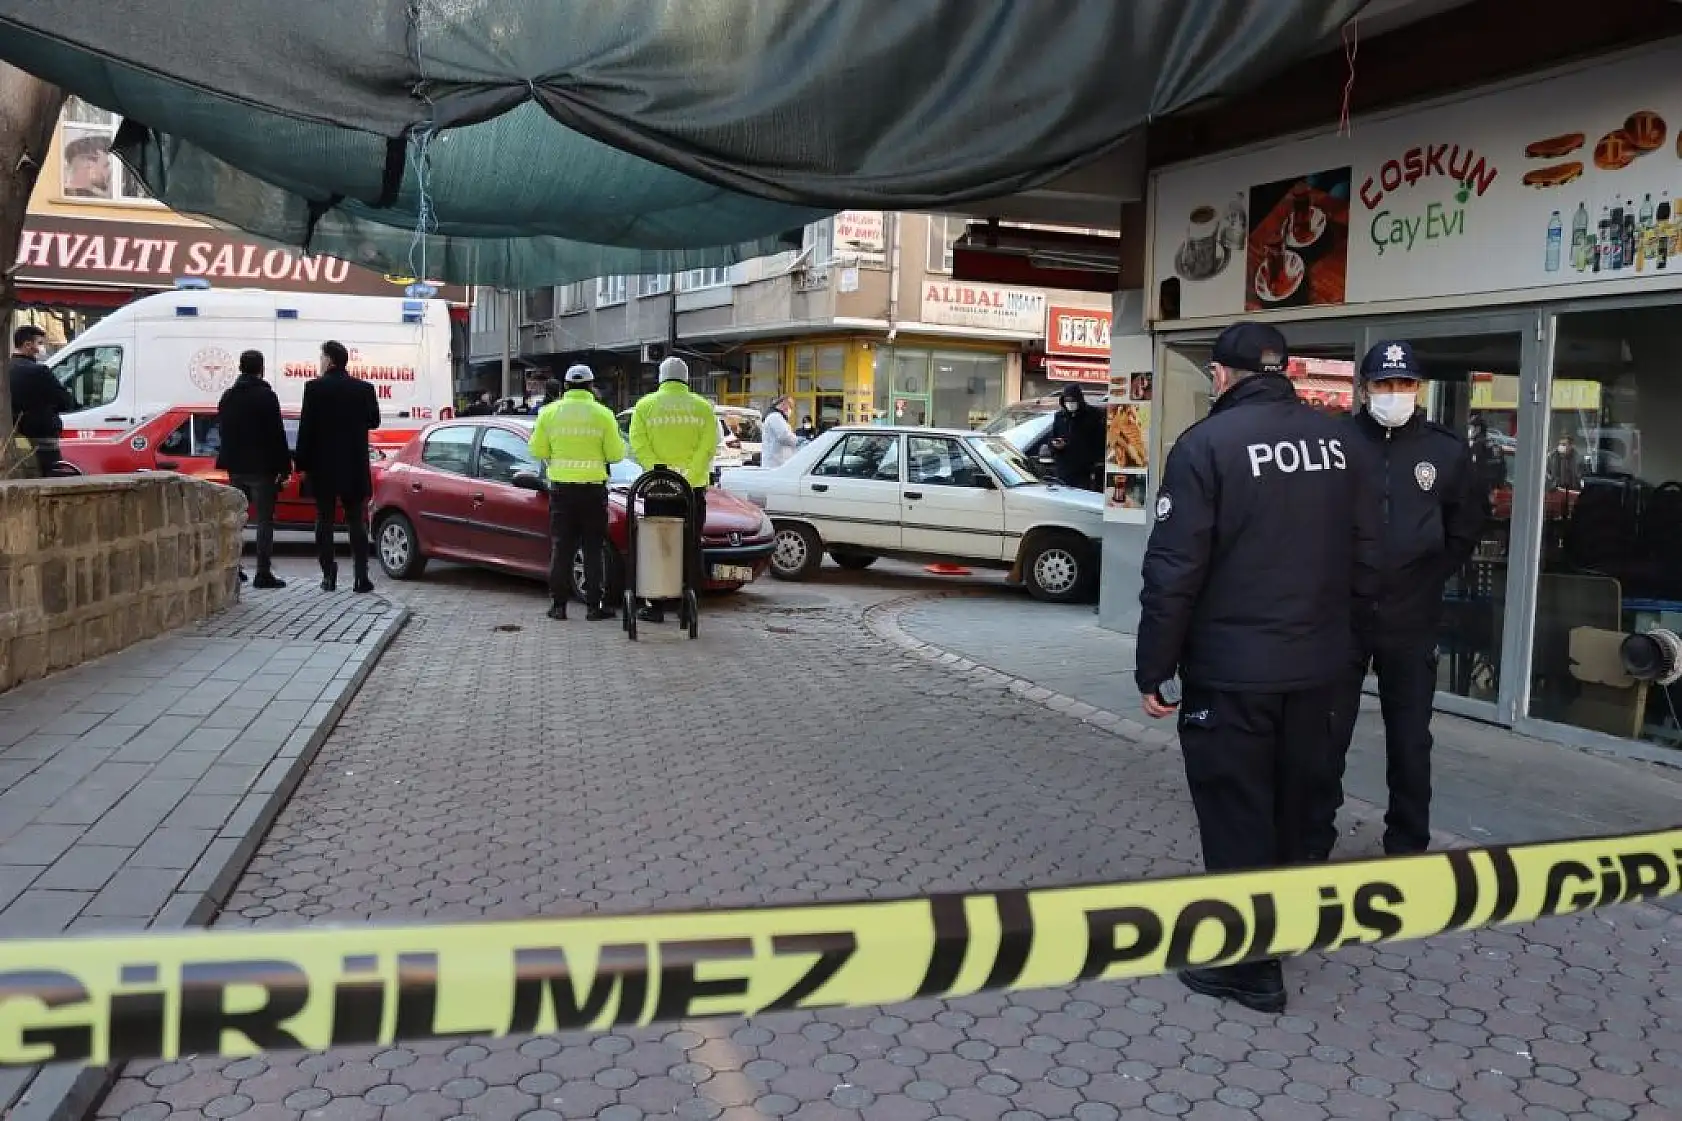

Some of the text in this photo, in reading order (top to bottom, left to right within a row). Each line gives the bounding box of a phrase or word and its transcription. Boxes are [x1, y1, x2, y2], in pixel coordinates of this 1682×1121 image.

[1360, 144, 1497, 209] COŞKUN
[1371, 202, 1464, 255] Çay Evi
[184, 241, 350, 282] SALONU
[347, 363, 415, 382] AKANLIĞI
[412, 406, 433, 419] 112
[1247, 438, 1346, 477] POLİS
[1077, 880, 1406, 981] POLİS
